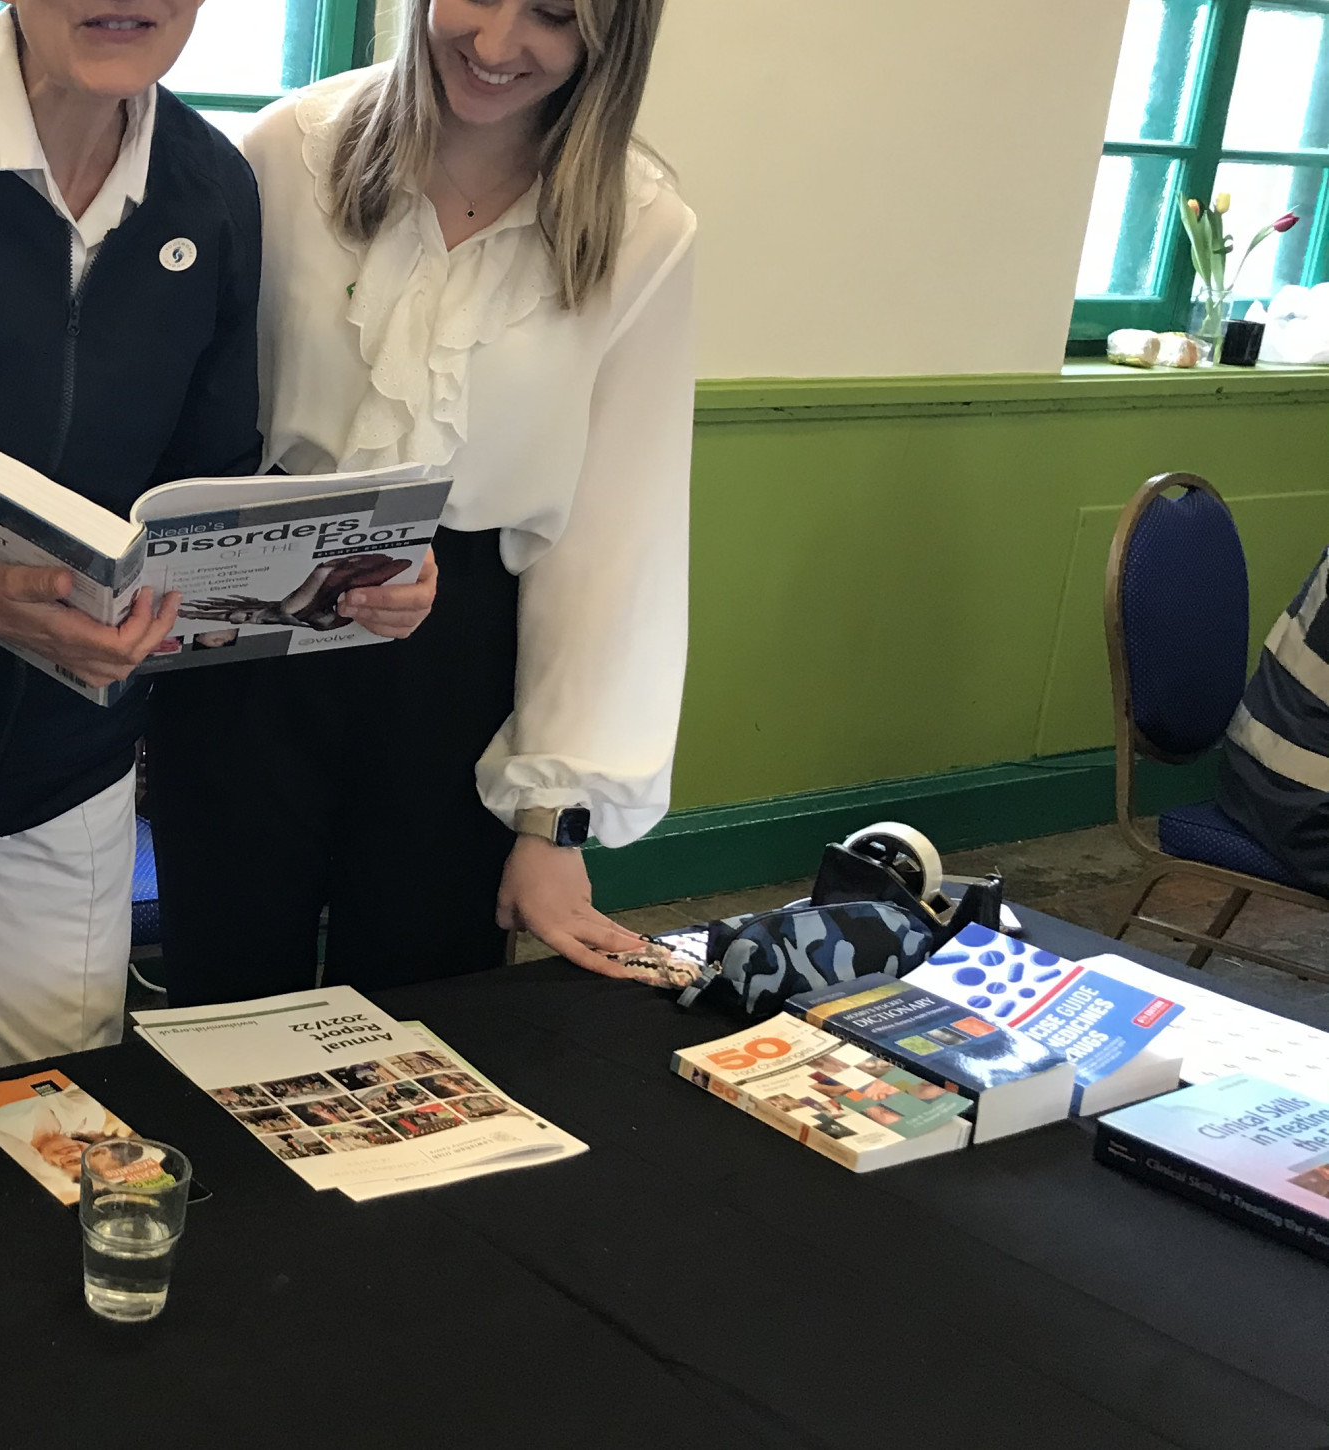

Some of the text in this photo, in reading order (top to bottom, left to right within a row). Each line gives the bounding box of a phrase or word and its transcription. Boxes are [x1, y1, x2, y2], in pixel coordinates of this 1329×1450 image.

[147, 521, 225, 540] Neale's
[147, 519, 359, 557] Disorders
[315, 526, 415, 550] FOOT
[1055, 984, 1100, 1017] GUIDE
[852, 996, 936, 1028] DICTIONARY
[288, 1014, 369, 1032] 2021/22
[309, 1023, 382, 1041] Report
[321, 1032, 393, 1053] Annual
[706, 1037, 792, 1070] 50
[1197, 1096, 1311, 1140] Clinical Skills
[1241, 1133, 1268, 1146] in
[1292, 1137, 1329, 1152] the
[1306, 1226, 1329, 1246] Foo
